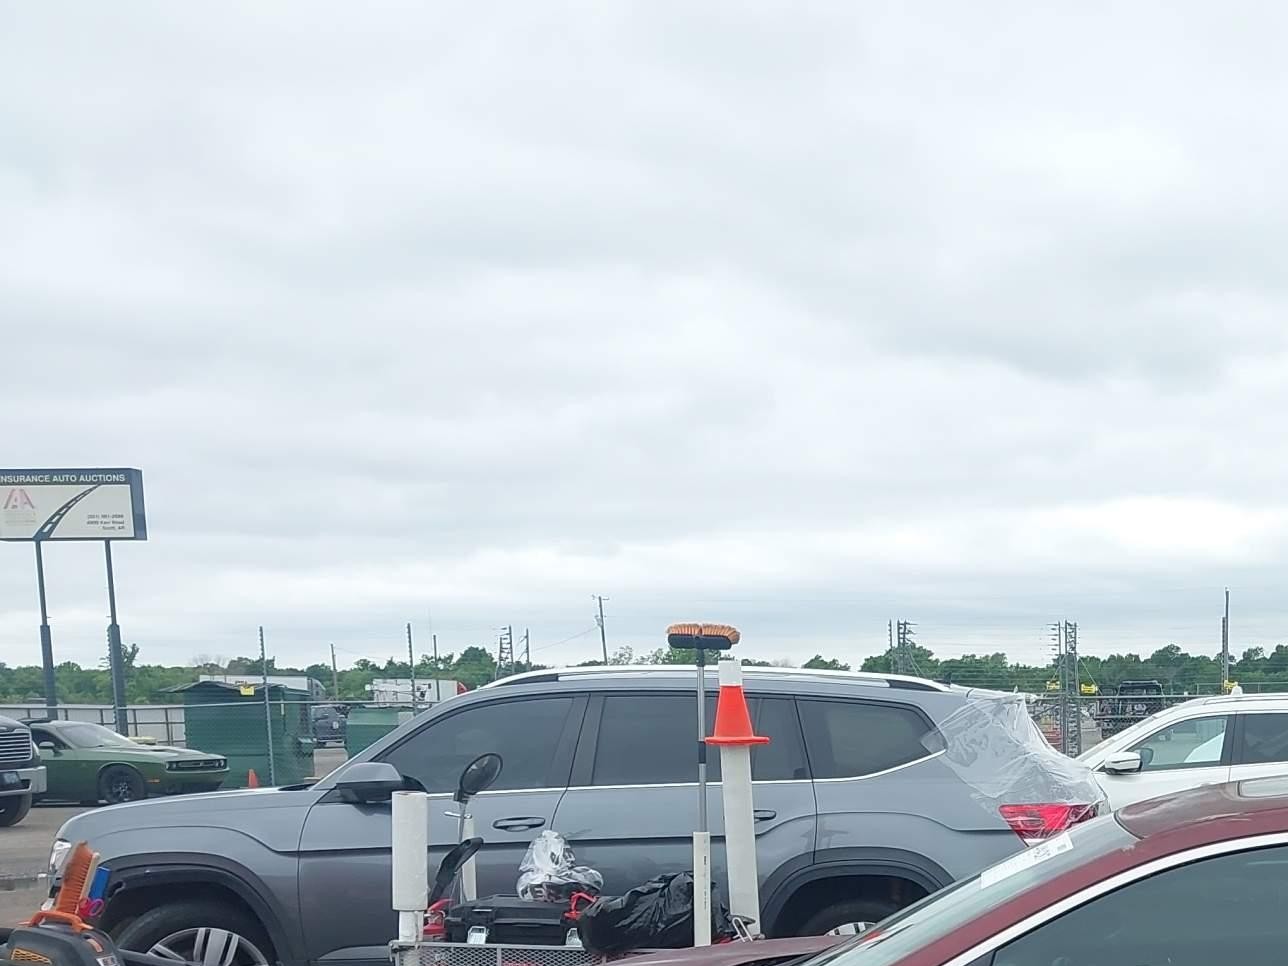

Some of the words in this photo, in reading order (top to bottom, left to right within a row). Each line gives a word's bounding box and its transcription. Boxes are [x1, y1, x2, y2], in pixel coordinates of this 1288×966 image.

[0, 474, 50, 483] NSURANCE
[52, 474, 77, 482] AUTO
[79, 474, 126, 482] AUCTIONS
